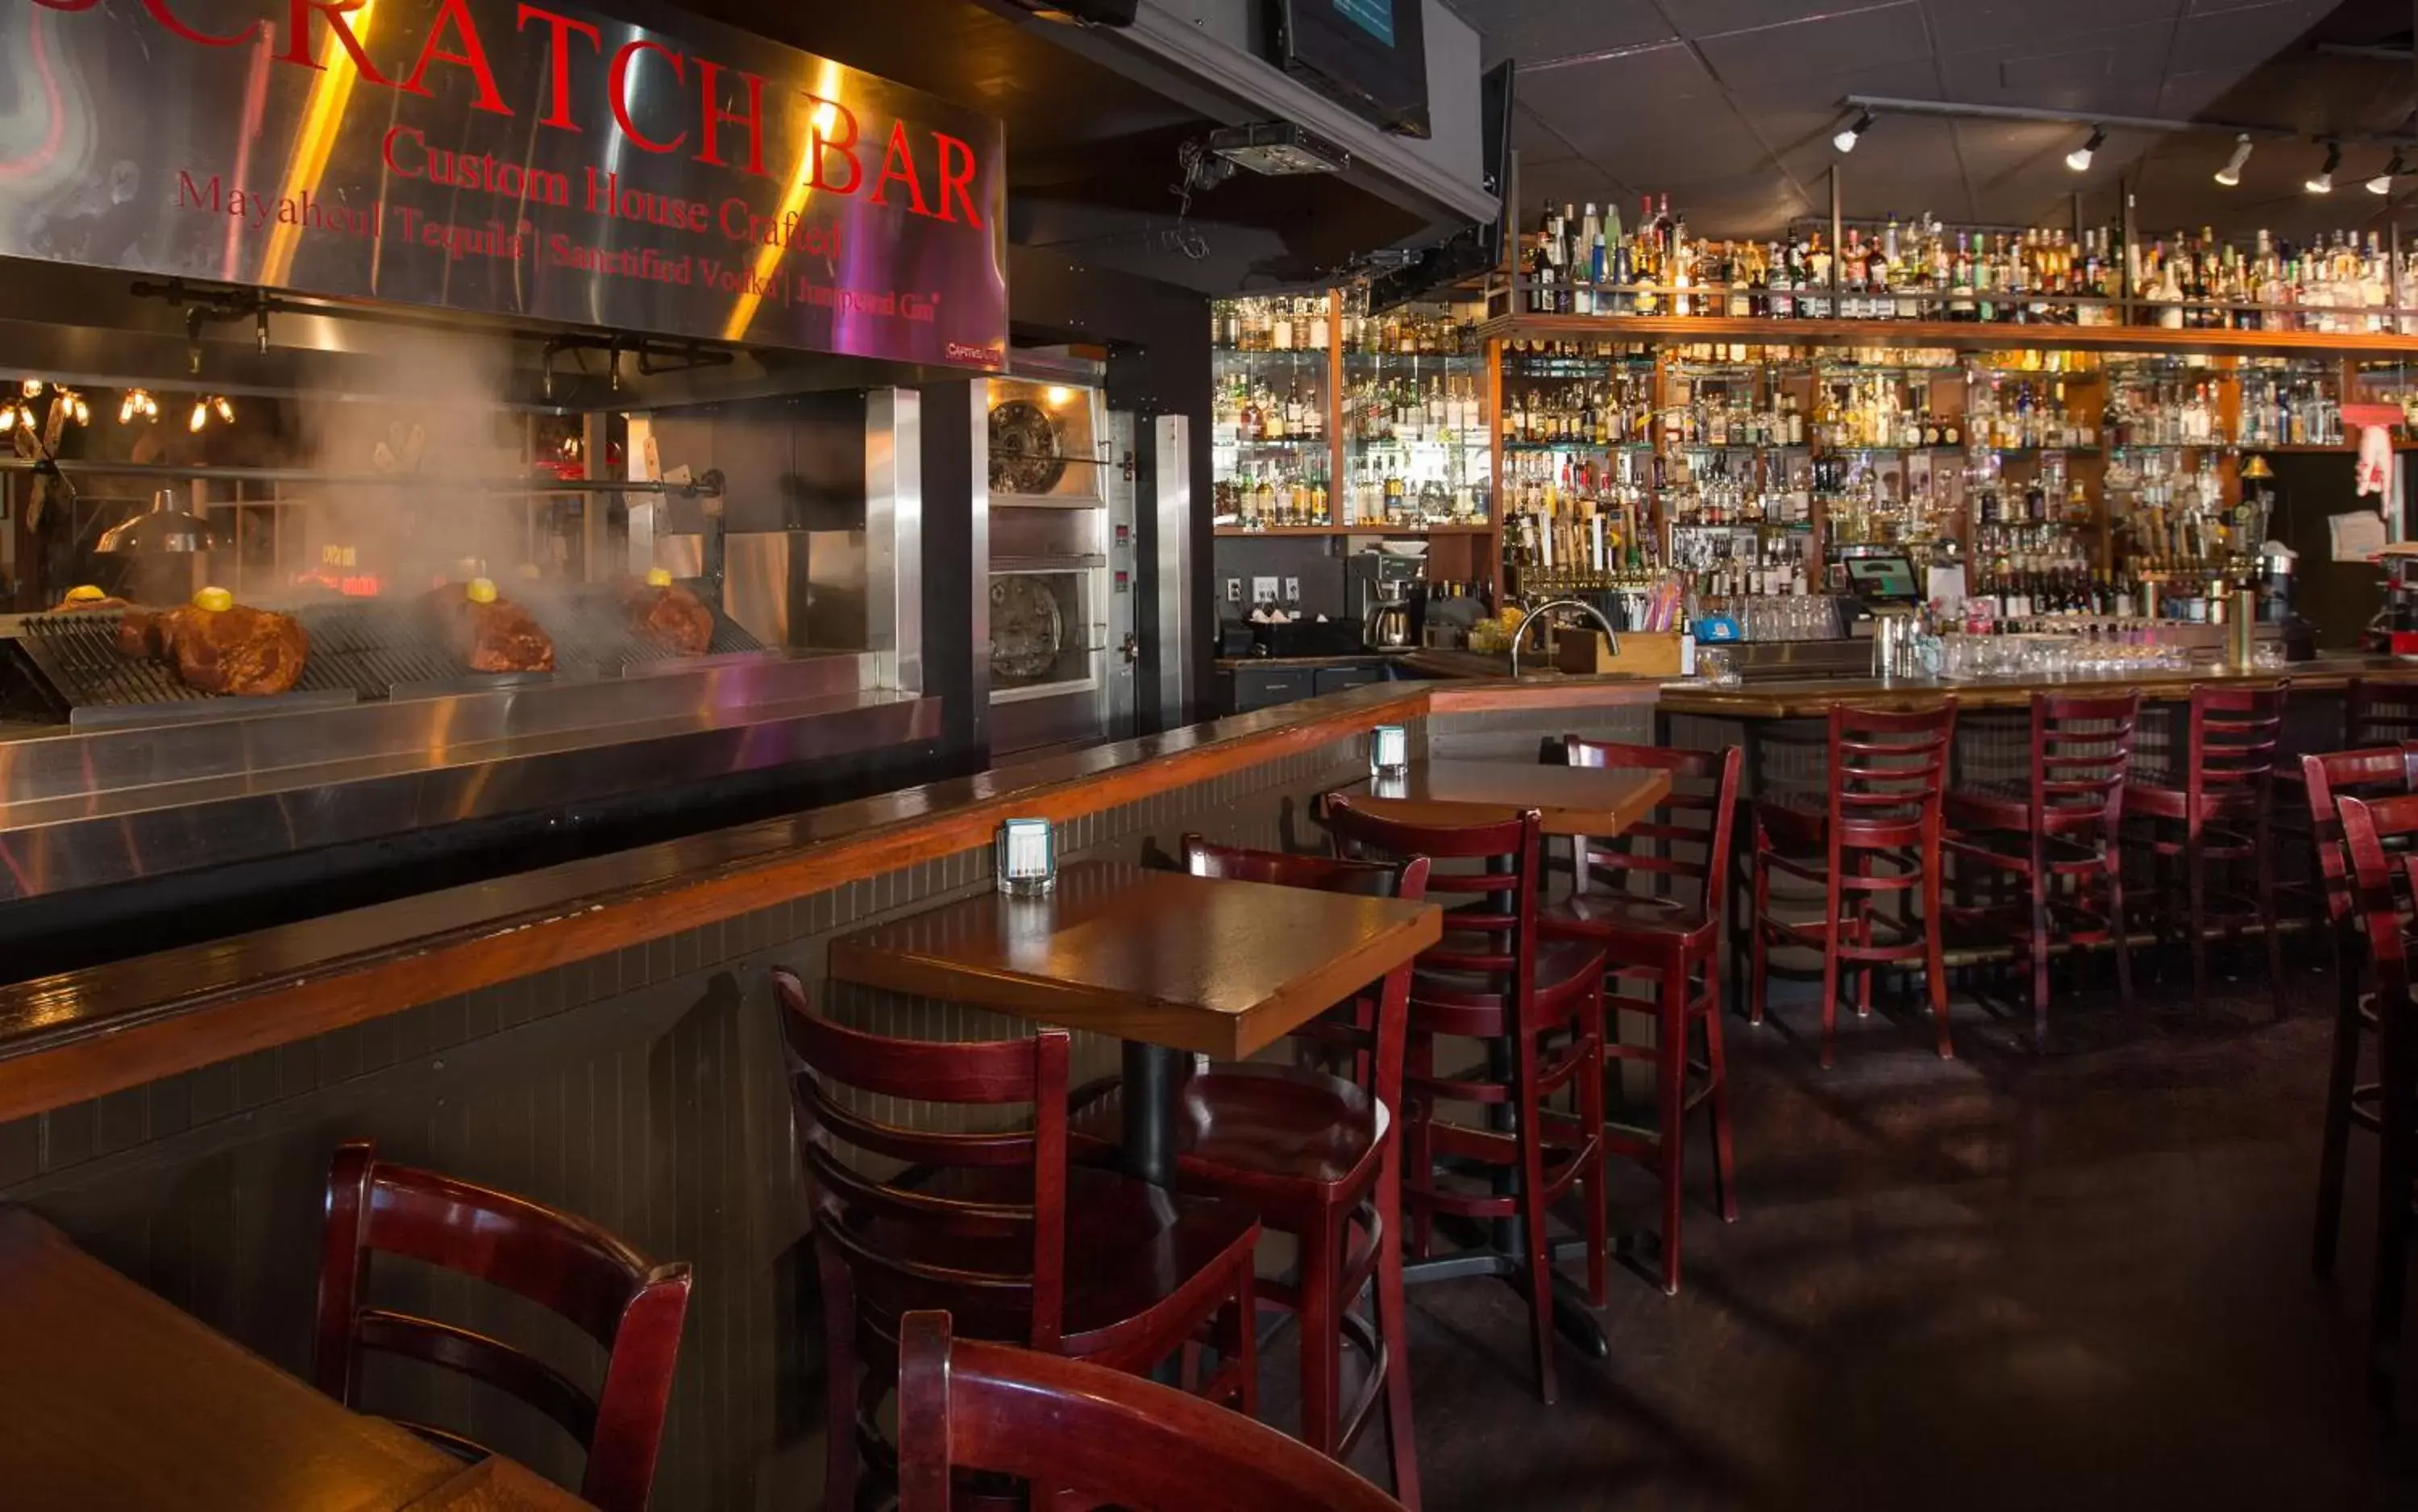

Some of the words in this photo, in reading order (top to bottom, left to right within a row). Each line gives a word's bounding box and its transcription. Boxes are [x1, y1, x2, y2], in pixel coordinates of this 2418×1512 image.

[27, 0, 774, 177] RATCH
[796, 90, 985, 232] BAR
[383, 124, 569, 207] Custom
[584, 165, 710, 234] House
[718, 197, 841, 259] Crafted
[550, 233, 692, 285] Sanctified
